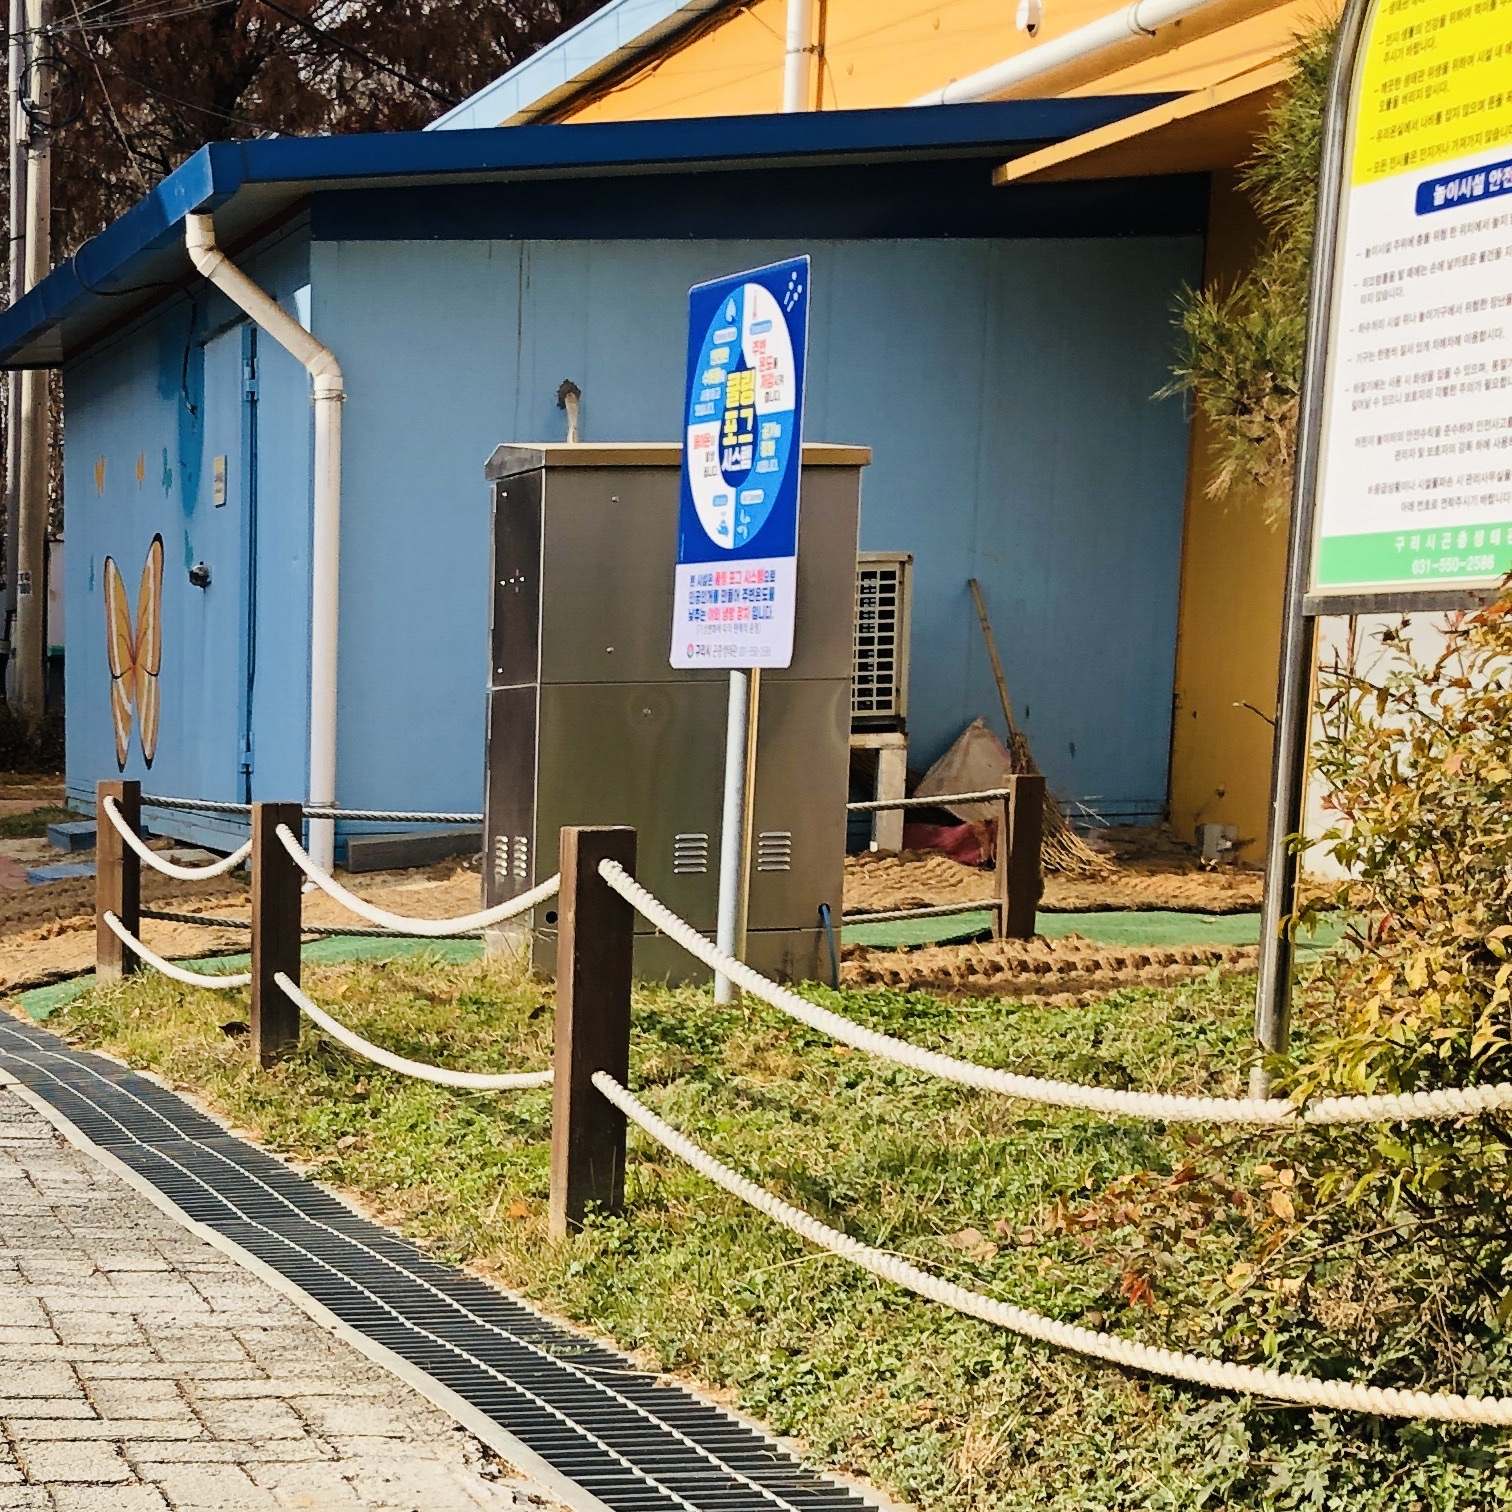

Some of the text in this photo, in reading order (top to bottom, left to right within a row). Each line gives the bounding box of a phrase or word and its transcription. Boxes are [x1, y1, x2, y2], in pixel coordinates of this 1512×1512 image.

[1476, 48, 1491, 63] 시설
[1433, 171, 1485, 206] 놀이시설
[1364, 242, 1392, 258] 놀이시설
[725, 366, 755, 409] 쿨링
[722, 406, 754, 446] 포그
[721, 444, 752, 473] 시스템
[728, 570, 741, 584] 포그
